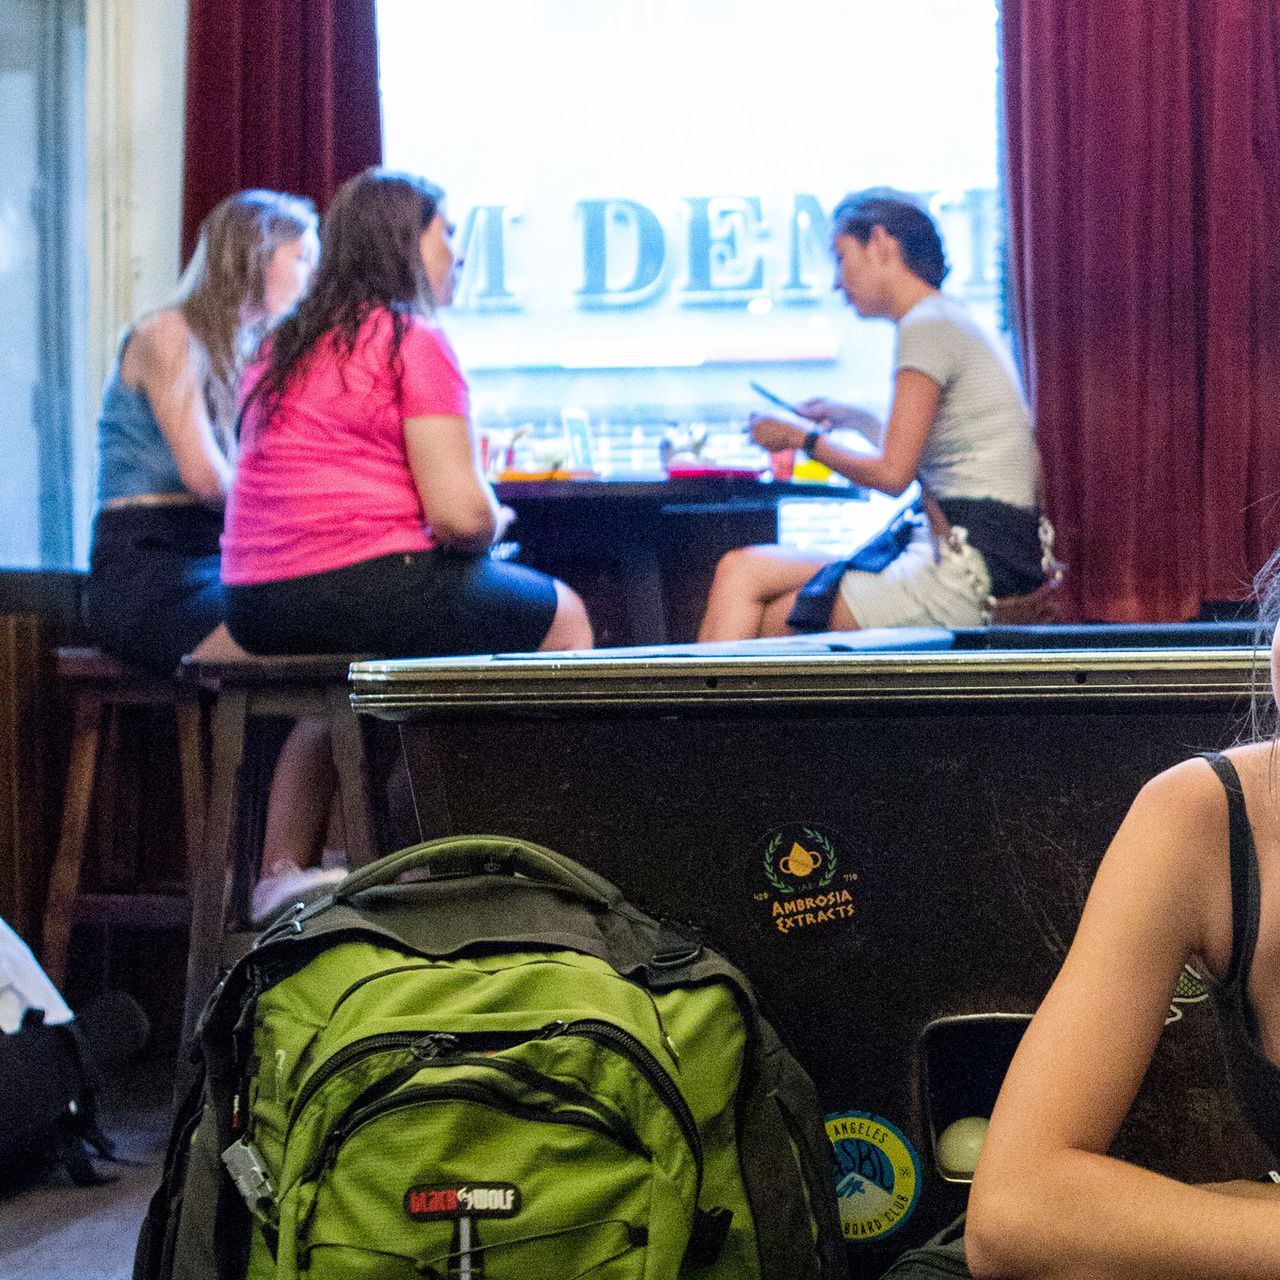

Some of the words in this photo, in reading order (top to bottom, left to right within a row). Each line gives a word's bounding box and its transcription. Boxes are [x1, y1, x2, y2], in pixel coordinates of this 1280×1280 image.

[772, 889, 852, 917] AMBROSIA
[775, 904, 855, 934] EXTRACTS
[833, 1122, 888, 1144] ANGELES
[844, 1219, 882, 1235] BOARD
[884, 1194, 909, 1222] CLUB
